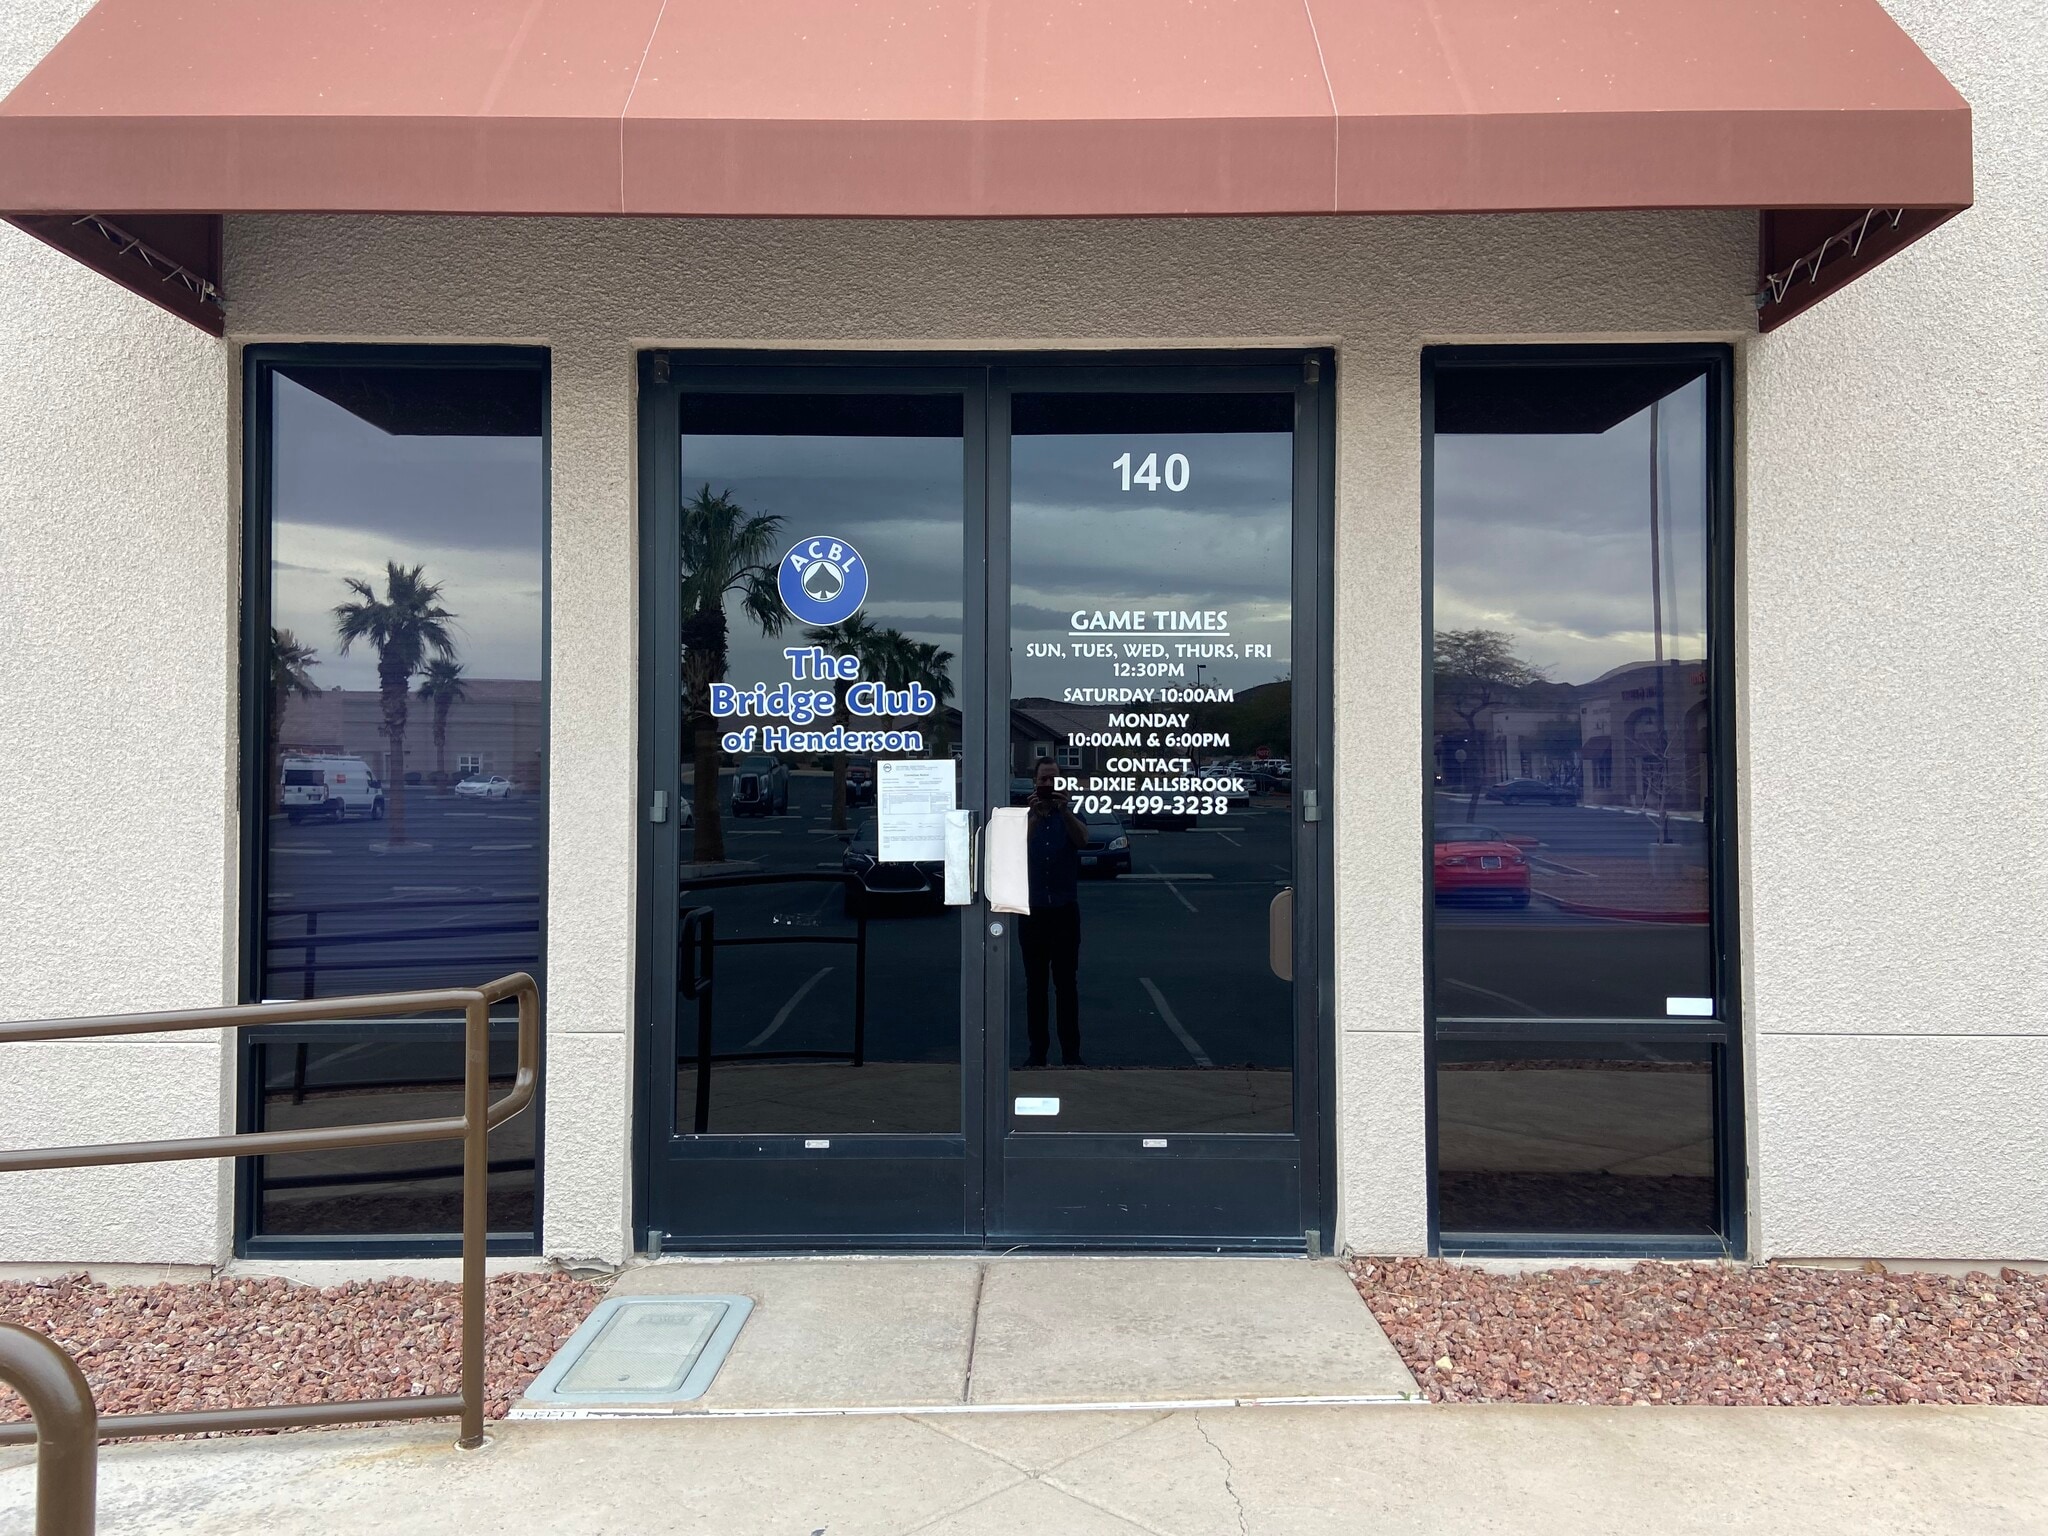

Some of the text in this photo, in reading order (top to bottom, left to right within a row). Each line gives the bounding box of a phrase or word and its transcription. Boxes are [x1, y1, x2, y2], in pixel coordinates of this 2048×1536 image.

[1112, 452, 1190, 492] 140
[789, 541, 857, 573] ACBL
[1070, 609, 1228, 631] GAME TIMES
[1026, 642, 1272, 660] SUN, TUES, WED, THURS, FRI
[784, 646, 860, 681] The
[1113, 662, 1185, 677] 12:30PM
[709, 681, 936, 725] Bridge Club
[1063, 687, 1234, 703] SATURDAY 10:00AM
[1108, 713, 1190, 728] MONDAY
[721, 725, 923, 753] of Henderson
[1067, 732, 1230, 748] 10:00AM & 6:00PM
[1106, 757, 1192, 773] CONTACT
[1053, 776, 1245, 792] DR. DIXIE ALLSBROOK
[1071, 795, 1228, 815] 702-499-3238
